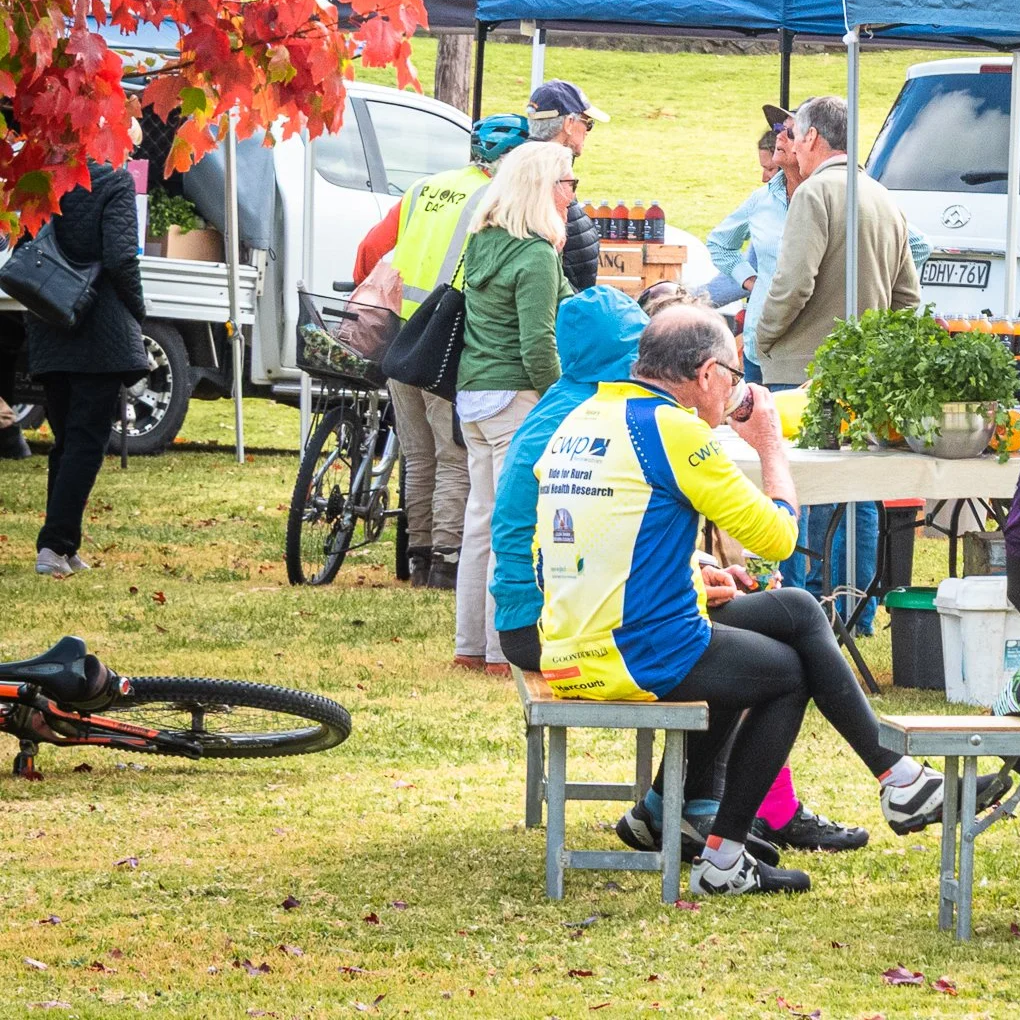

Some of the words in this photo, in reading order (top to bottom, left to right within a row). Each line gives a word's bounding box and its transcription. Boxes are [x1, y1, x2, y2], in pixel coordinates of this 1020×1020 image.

[561, 469, 570, 478] for
[570, 468, 592, 480] Rural
[551, 484, 570, 494] Health
[571, 484, 614, 497] Research
[555, 679, 606, 693] Harcourts
